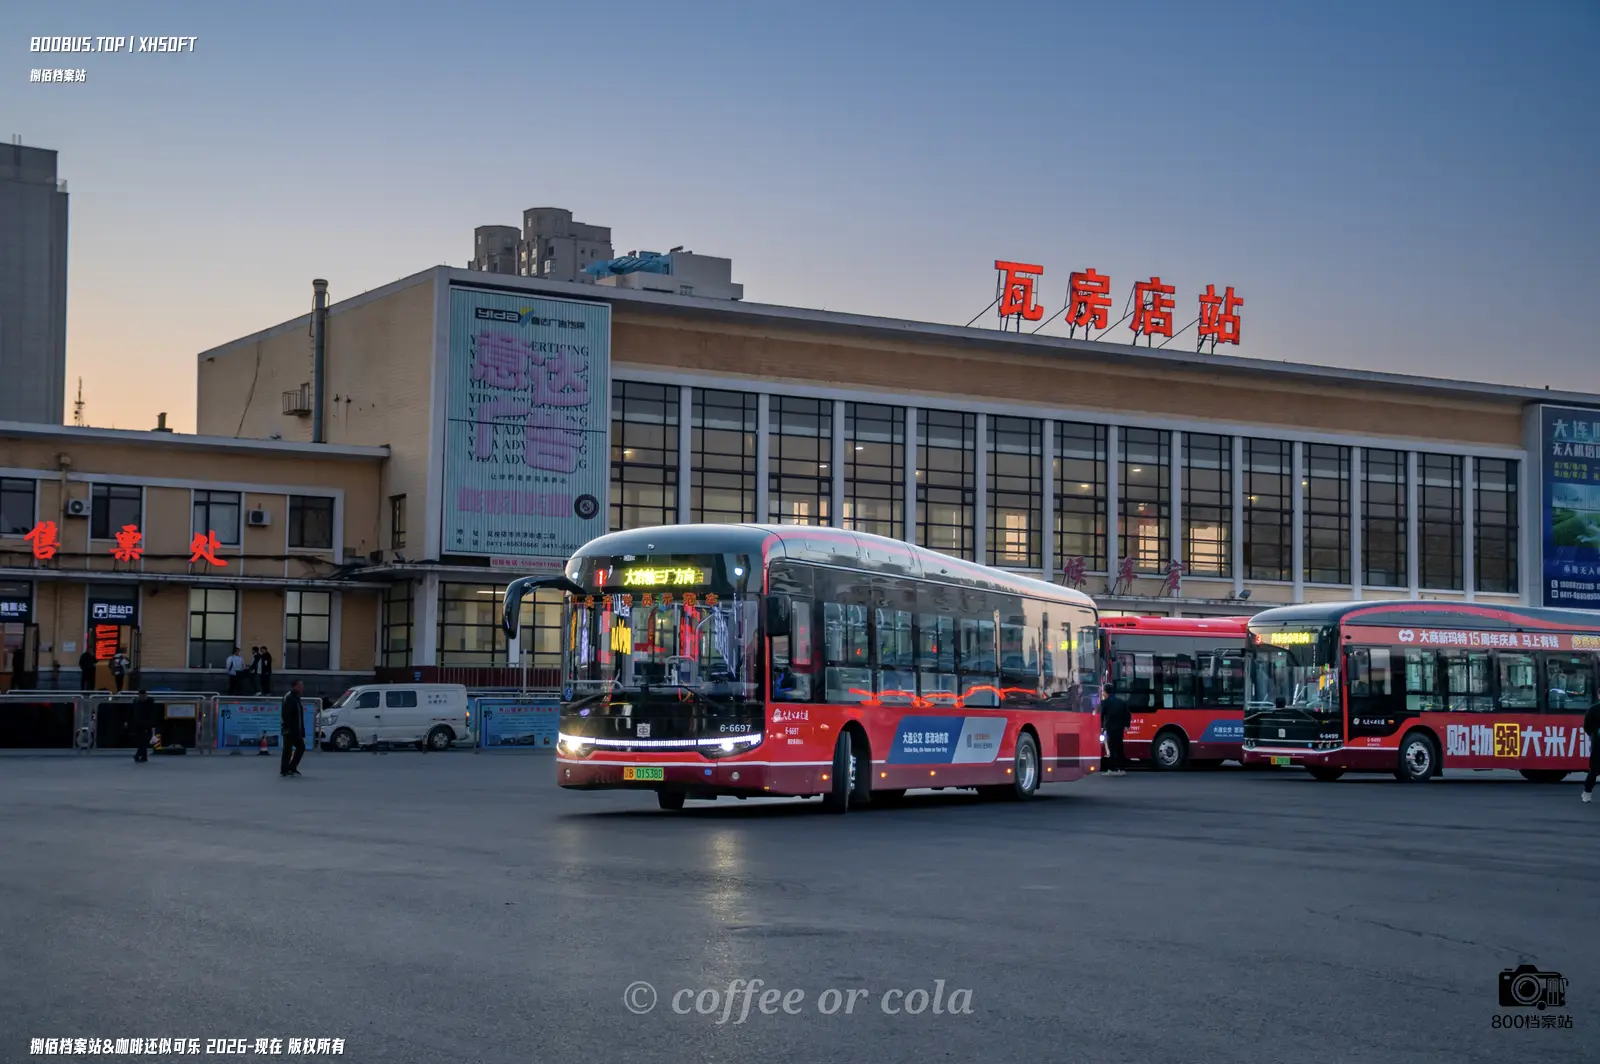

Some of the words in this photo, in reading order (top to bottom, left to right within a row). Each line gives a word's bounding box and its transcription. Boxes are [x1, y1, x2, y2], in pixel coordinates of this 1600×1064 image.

[994, 260, 1244, 345] 瓦房店站
[1552, 419, 1600, 440] 大连
[24, 520, 228, 567] 售票处
[108, 605, 133, 614] 进站口
[1420, 630, 1518, 646] 大商新玛特15周年庆典
[1522, 634, 1559, 648] 马上有钱
[902, 732, 922, 744] 大连公交
